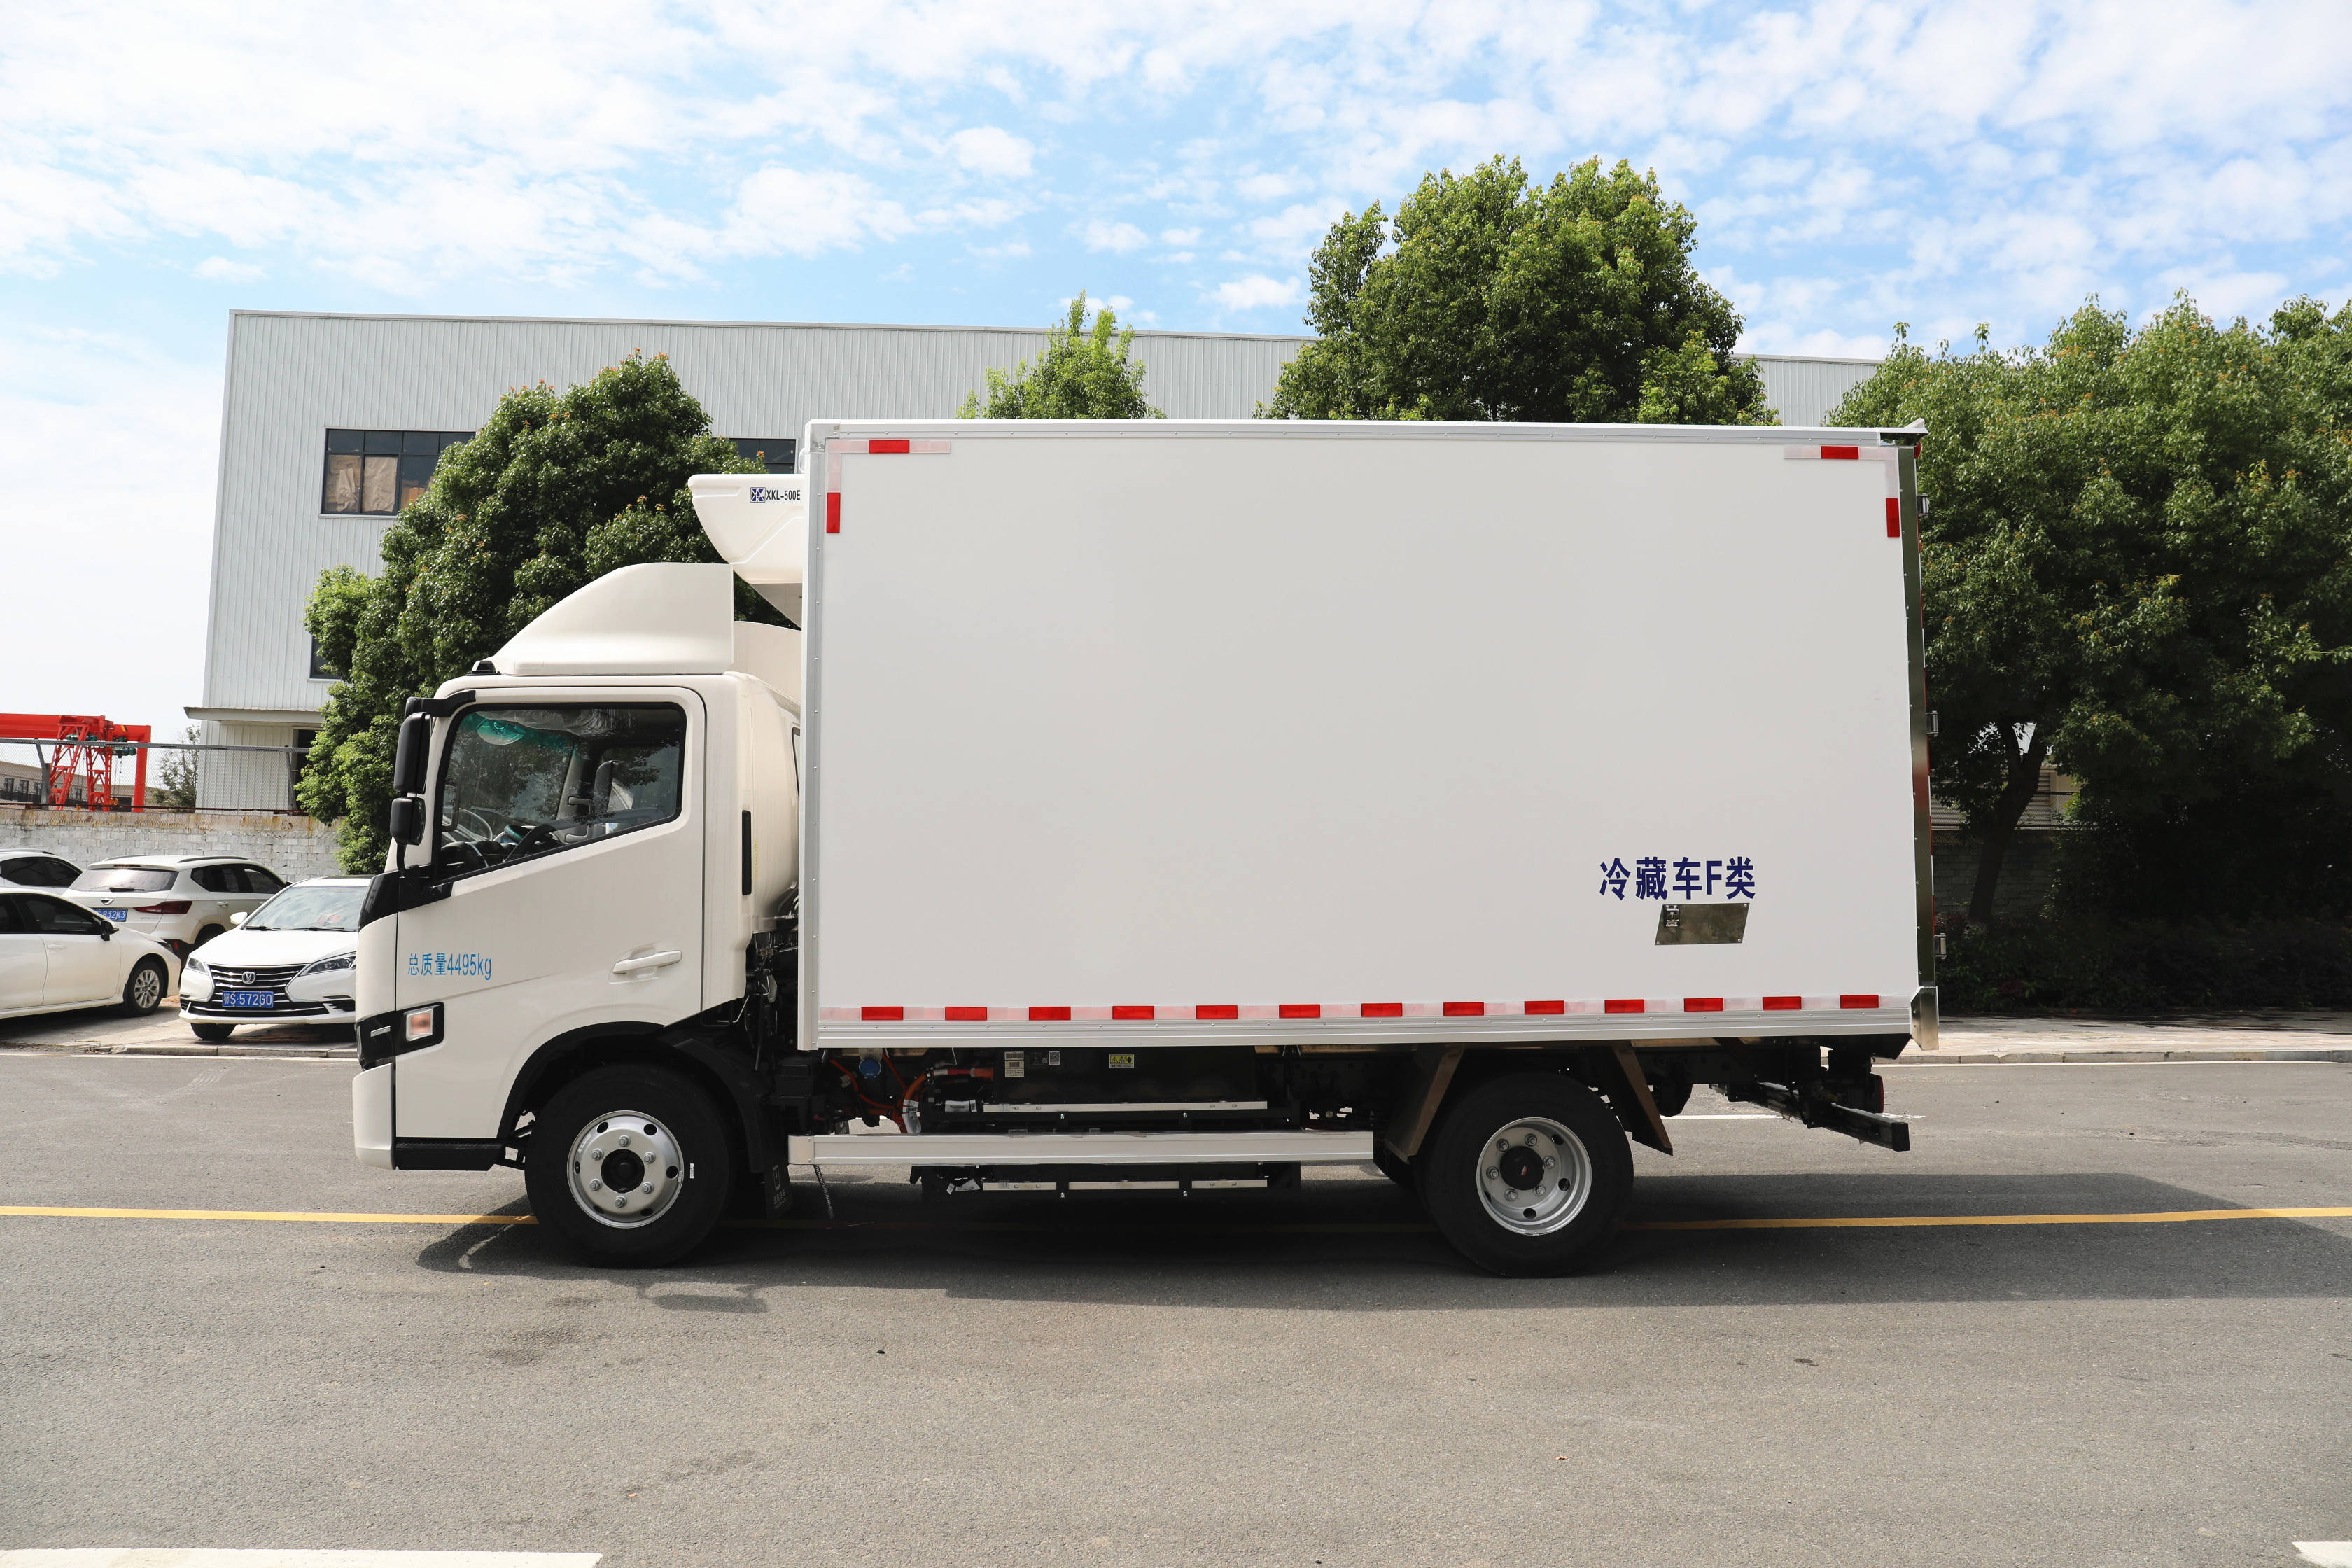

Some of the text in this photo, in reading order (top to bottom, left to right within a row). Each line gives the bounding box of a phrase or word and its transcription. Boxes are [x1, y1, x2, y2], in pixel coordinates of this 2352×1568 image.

[766, 489, 801, 500] XKL-500E
[1600, 856, 1756, 901] 冷藏车F类
[408, 953, 491, 980] 总质量4495kg
